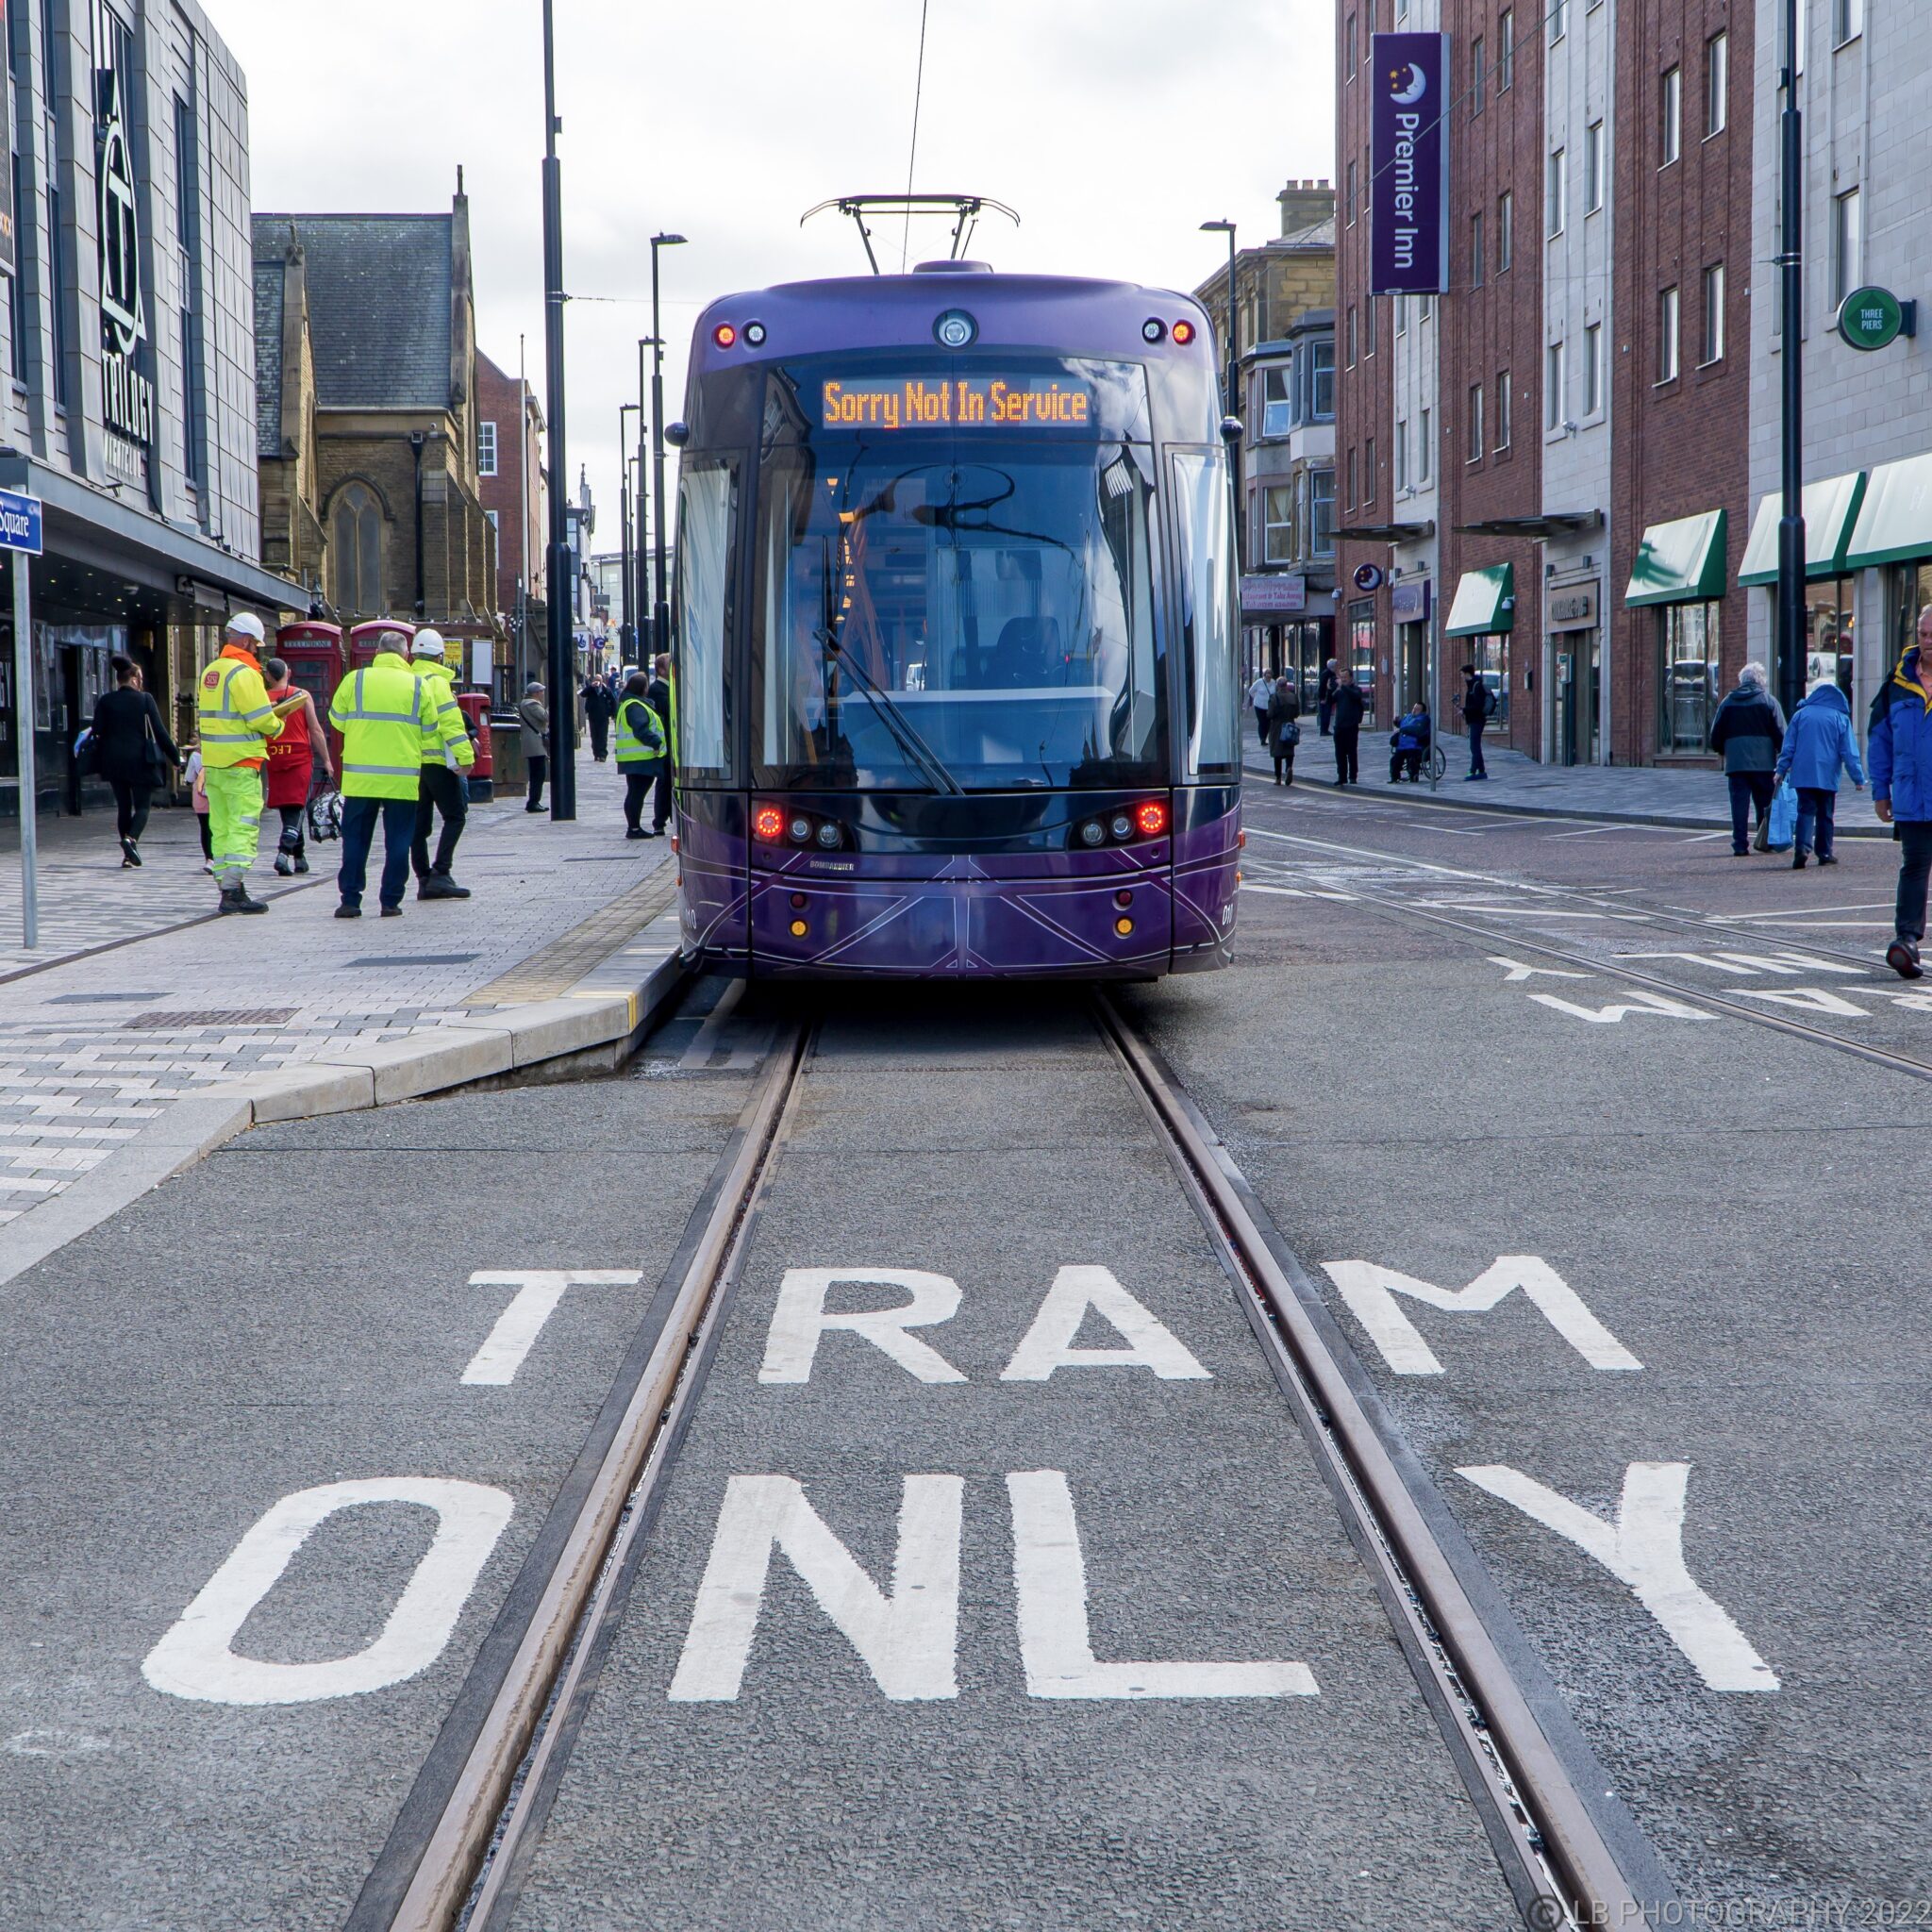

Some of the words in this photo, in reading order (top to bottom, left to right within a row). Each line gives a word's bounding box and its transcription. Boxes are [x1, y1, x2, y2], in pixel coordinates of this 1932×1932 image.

[1394, 113, 1419, 222] Premier
[1394, 228, 1418, 269] Inn
[1860, 308, 1884, 319] THREE
[1861, 320, 1882, 330] PIERS
[102, 348, 154, 446] TRILOGY
[824, 381, 899, 429] Sorry
[906, 381, 950, 422] Not
[958, 381, 984, 422] In
[991, 381, 1088, 421] Service
[270, 744, 291, 755] LFC
[809, 860, 855, 872] BOMBARDIER
[459, 1255, 1645, 1390] TRAM
[141, 1461, 1783, 1709] ONLY
